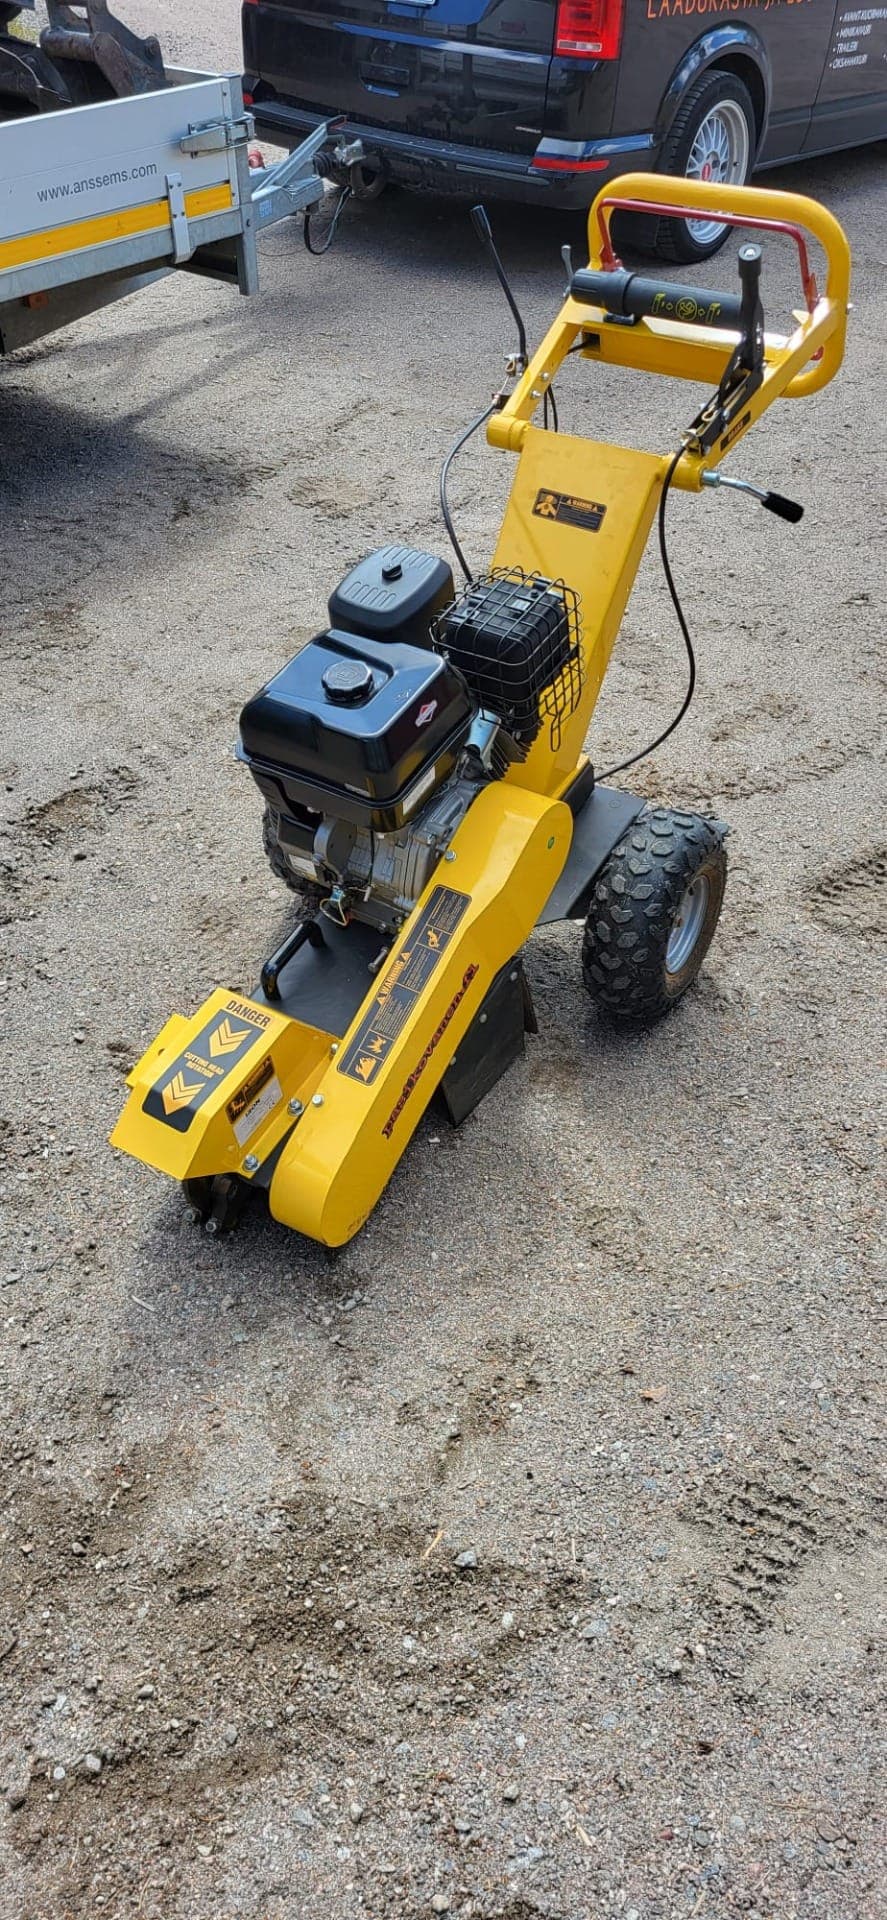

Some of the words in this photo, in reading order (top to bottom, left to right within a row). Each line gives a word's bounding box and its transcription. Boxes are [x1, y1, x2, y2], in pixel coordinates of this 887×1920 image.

[37, 163, 157, 202] www.anssems.com
[381, 957, 404, 996] WARNING
[225, 1000, 271, 1028] DANGER
